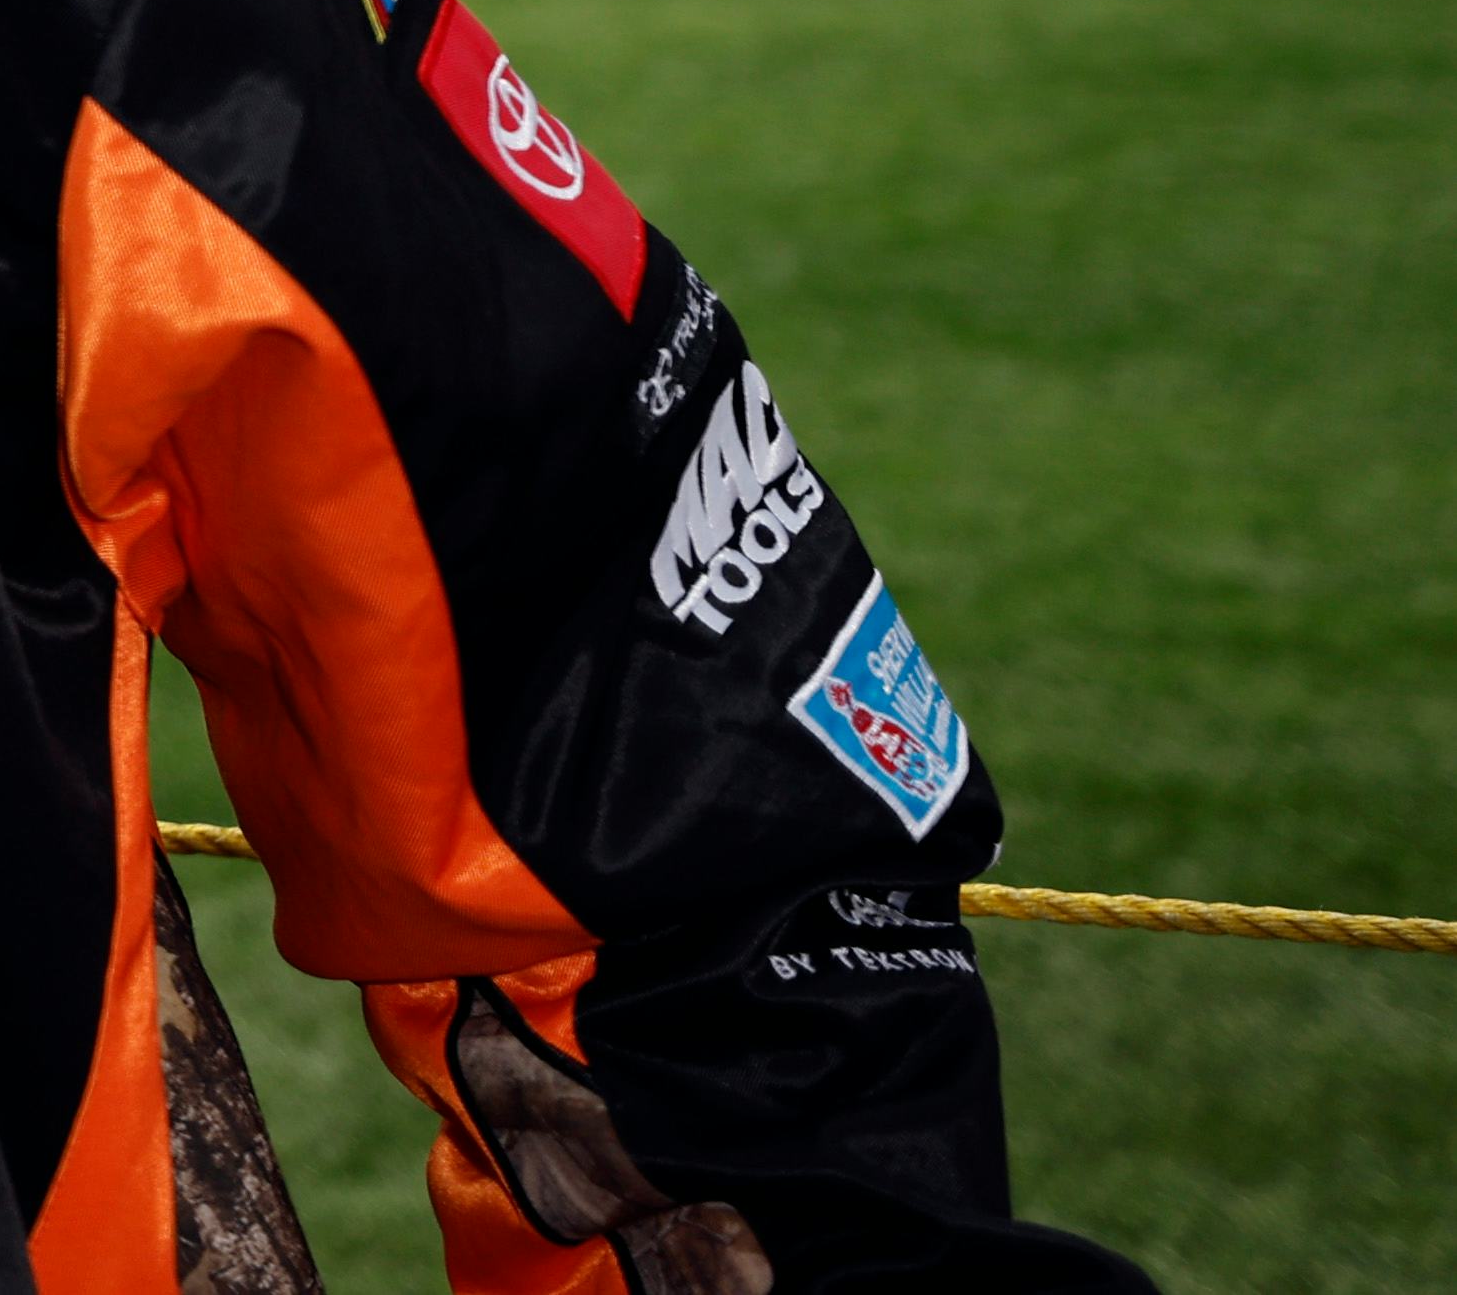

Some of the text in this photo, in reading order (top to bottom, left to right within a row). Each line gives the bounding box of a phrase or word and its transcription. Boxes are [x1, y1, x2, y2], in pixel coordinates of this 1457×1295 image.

[650, 360, 797, 609] MAC
[673, 454, 824, 635] TOOLS
[768, 953, 816, 980] BY
